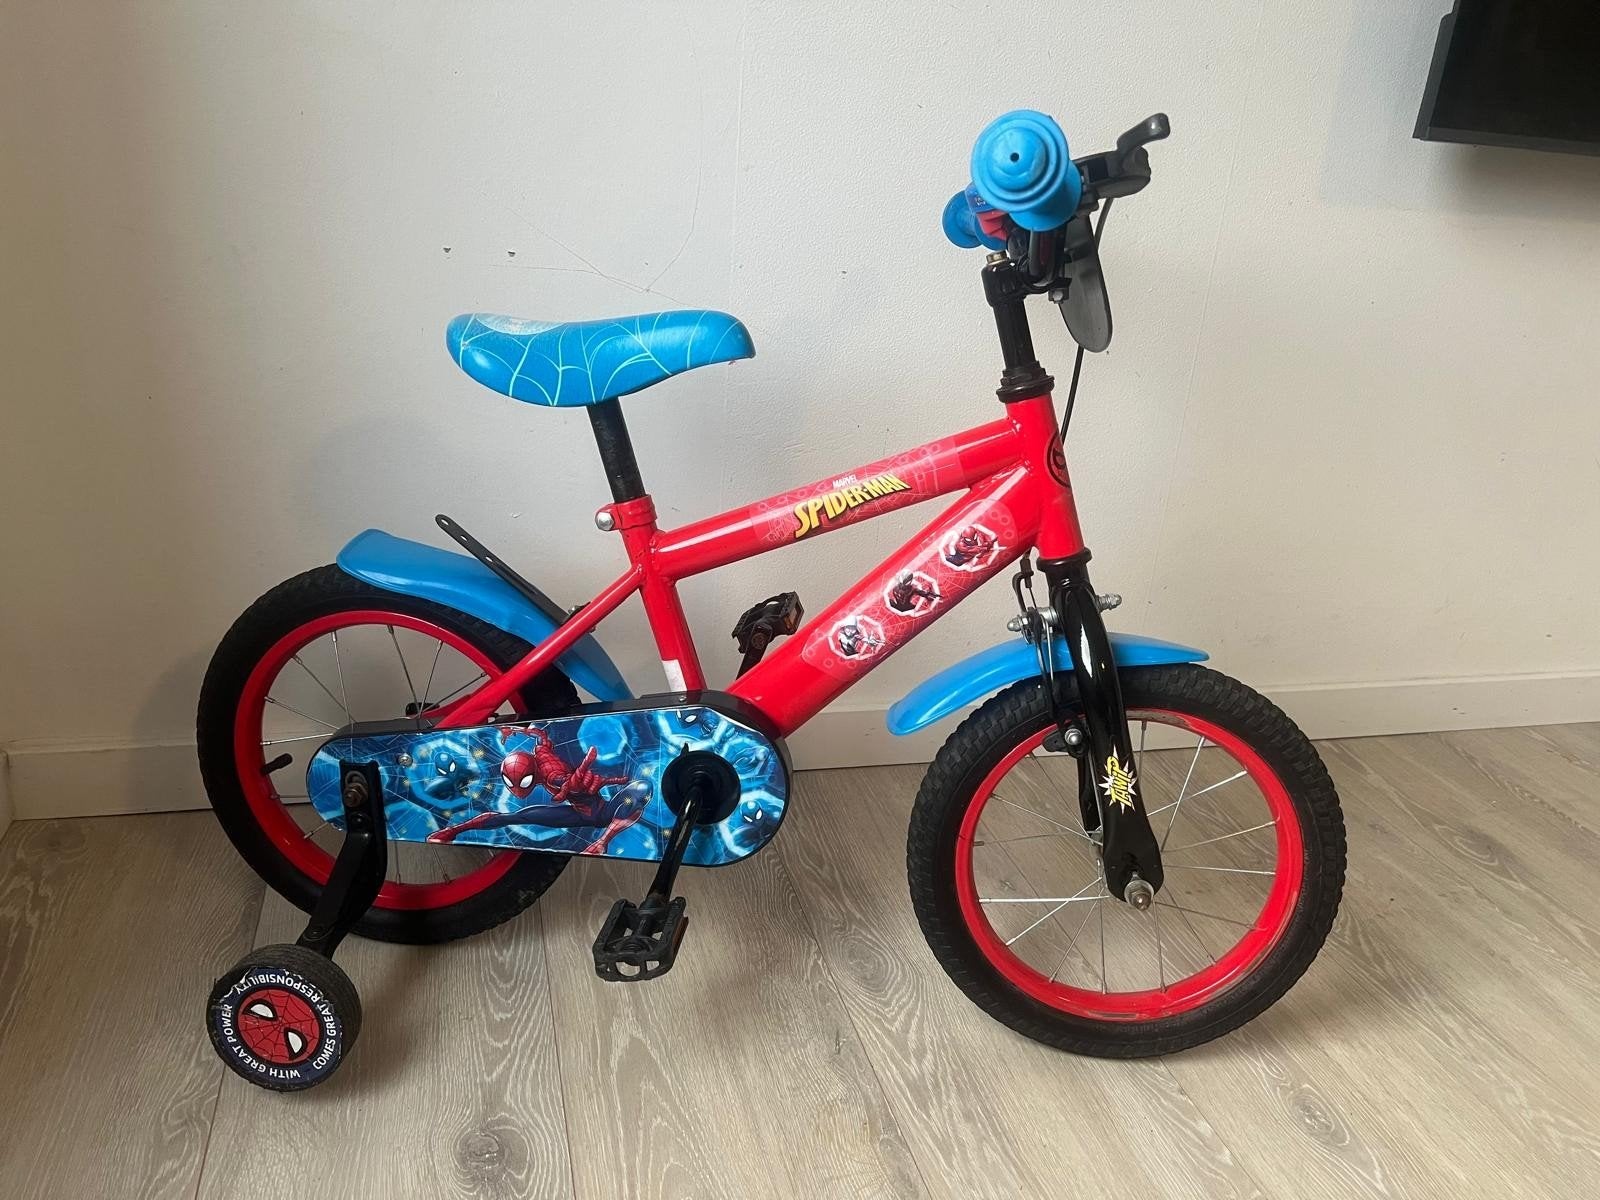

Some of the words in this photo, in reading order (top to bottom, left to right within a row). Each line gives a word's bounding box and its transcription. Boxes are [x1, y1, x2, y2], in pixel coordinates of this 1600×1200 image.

[832, 474, 858, 489] MARVEL
[793, 473, 912, 539] SPIDER-MAN
[234, 973, 321, 1003] RESPONSIBILITY
[221, 1003, 237, 1043] POWER
[316, 1000, 337, 1036] GREAT
[232, 1045, 267, 1073] GREAT
[312, 1038, 336, 1070] COMES
[269, 1067, 301, 1080] WITH
